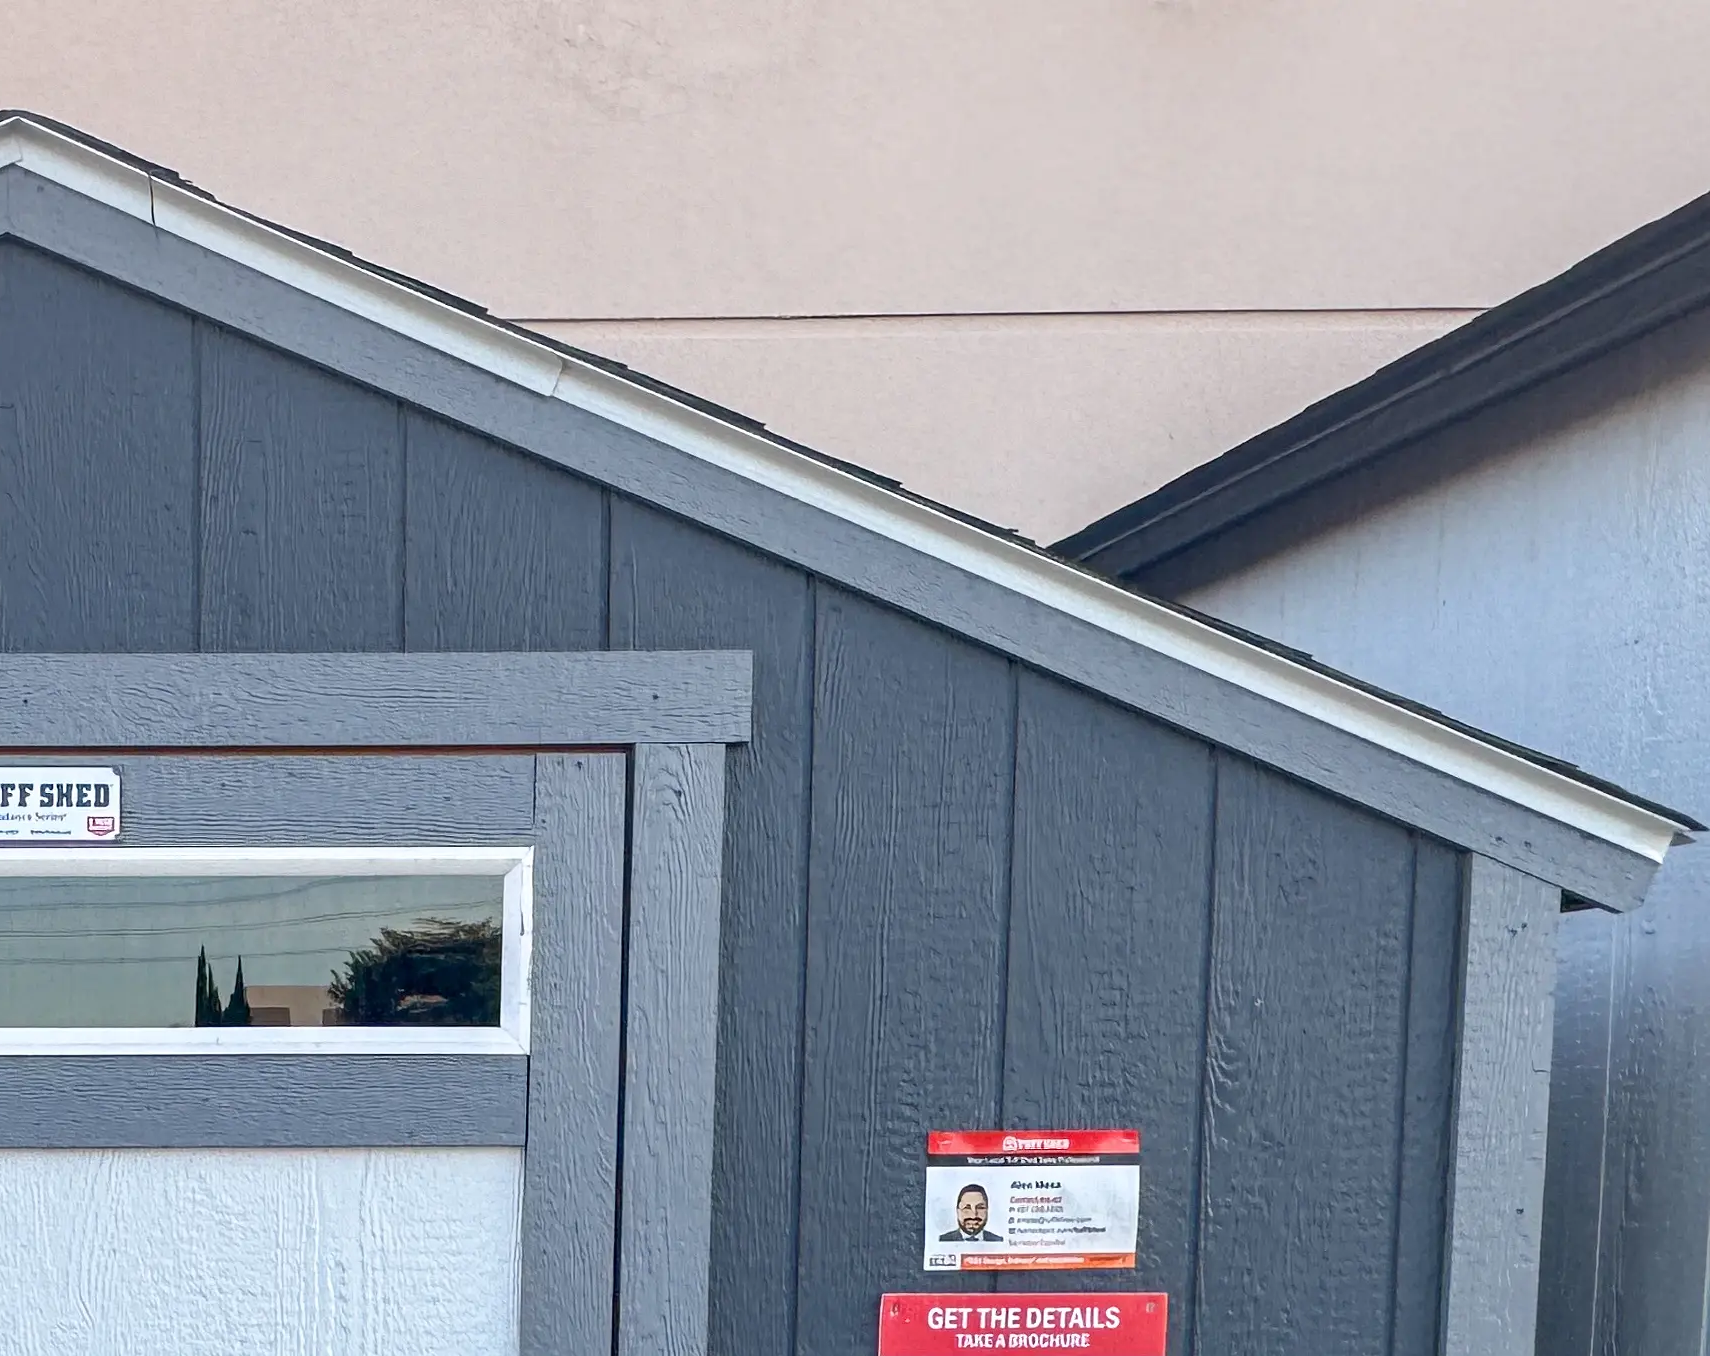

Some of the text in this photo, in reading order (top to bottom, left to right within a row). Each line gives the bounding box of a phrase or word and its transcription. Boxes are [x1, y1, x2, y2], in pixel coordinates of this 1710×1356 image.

[40, 783, 111, 808] SHED
[927, 1306, 1121, 1329] GET THE DETAILS
[955, 1332, 1091, 1348] TAKE A BROCHURE
